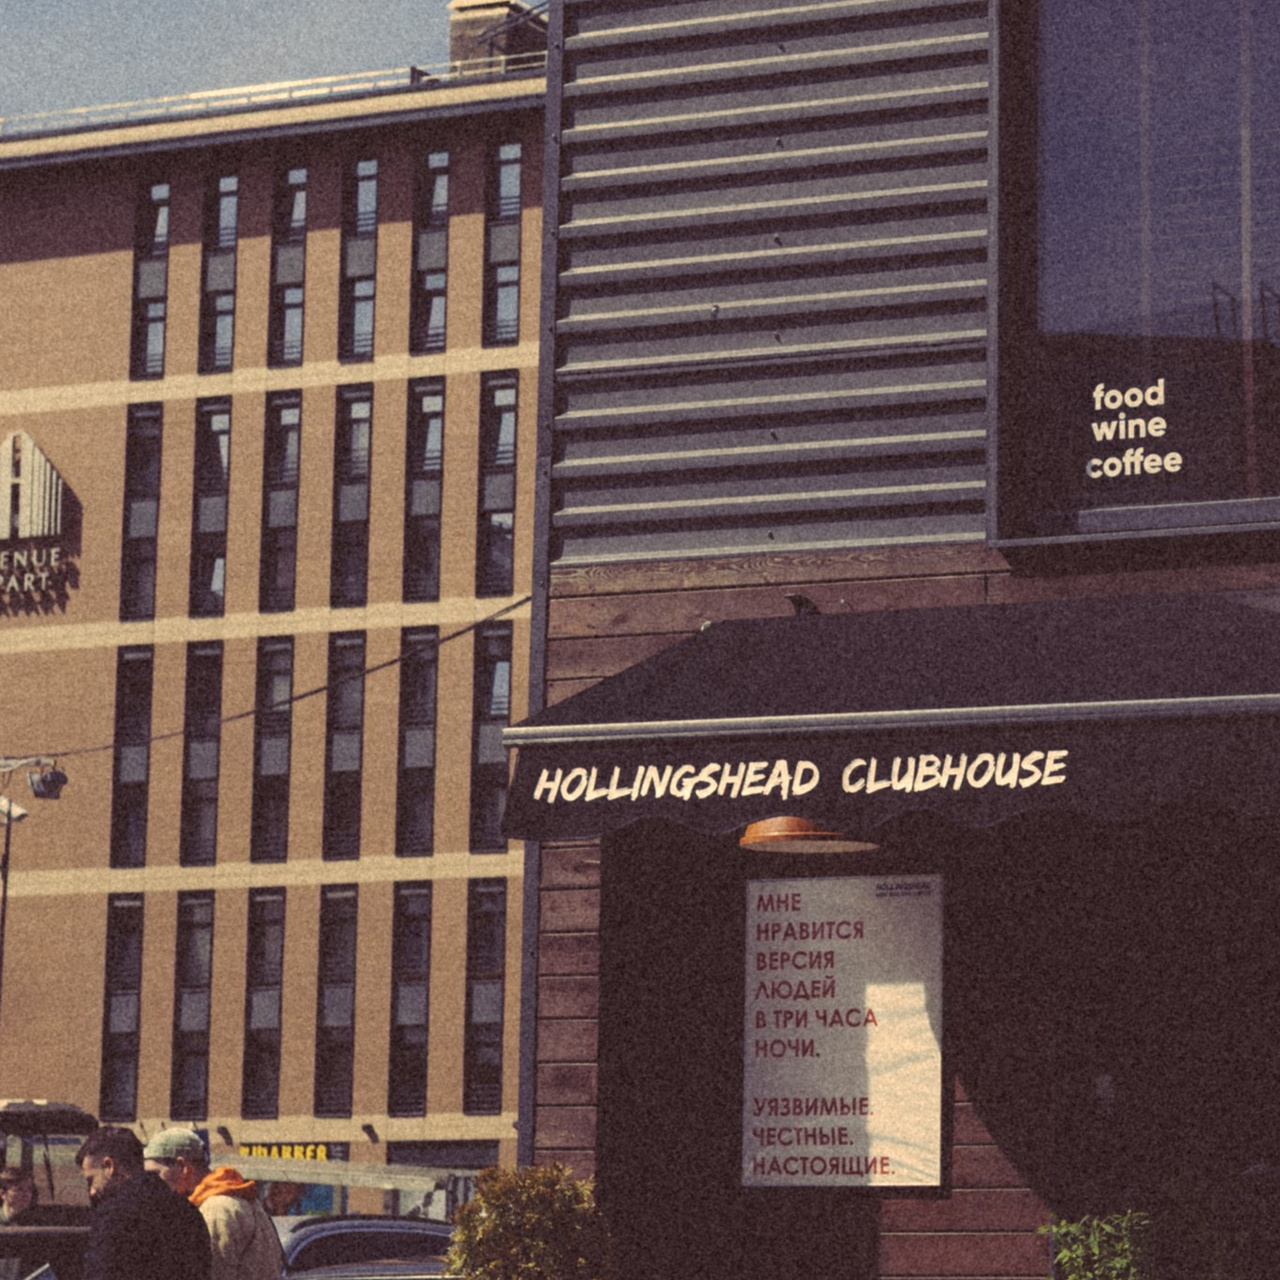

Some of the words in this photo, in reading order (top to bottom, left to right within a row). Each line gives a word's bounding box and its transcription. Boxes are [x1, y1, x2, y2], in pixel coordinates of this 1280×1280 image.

[1093, 378, 1165, 410] food
[1091, 412, 1167, 442] wine
[1086, 447, 1183, 479] coffee
[534, 759, 820, 803] HOLLINGSHEAD
[841, 750, 1069, 795] CLUBHOUSE
[756, 893, 801, 912] МНЕ
[756, 920, 864, 941] НРАВИТСЯ
[756, 951, 835, 970] ВЕРСИЯ
[755, 975, 836, 1001] ЛЮДЕЙ
[755, 1011, 767, 1029] В
[773, 1010, 808, 1028] ТРИ
[815, 1008, 878, 1028] ЧАСА
[755, 1039, 821, 1058] НОЧИ.
[753, 1097, 874, 1117] УЯЗВИМЫЕ.
[752, 1127, 854, 1146] ЧЕСТНЫЕ.
[752, 1156, 896, 1177] НАСТОЯЩИЕ.
